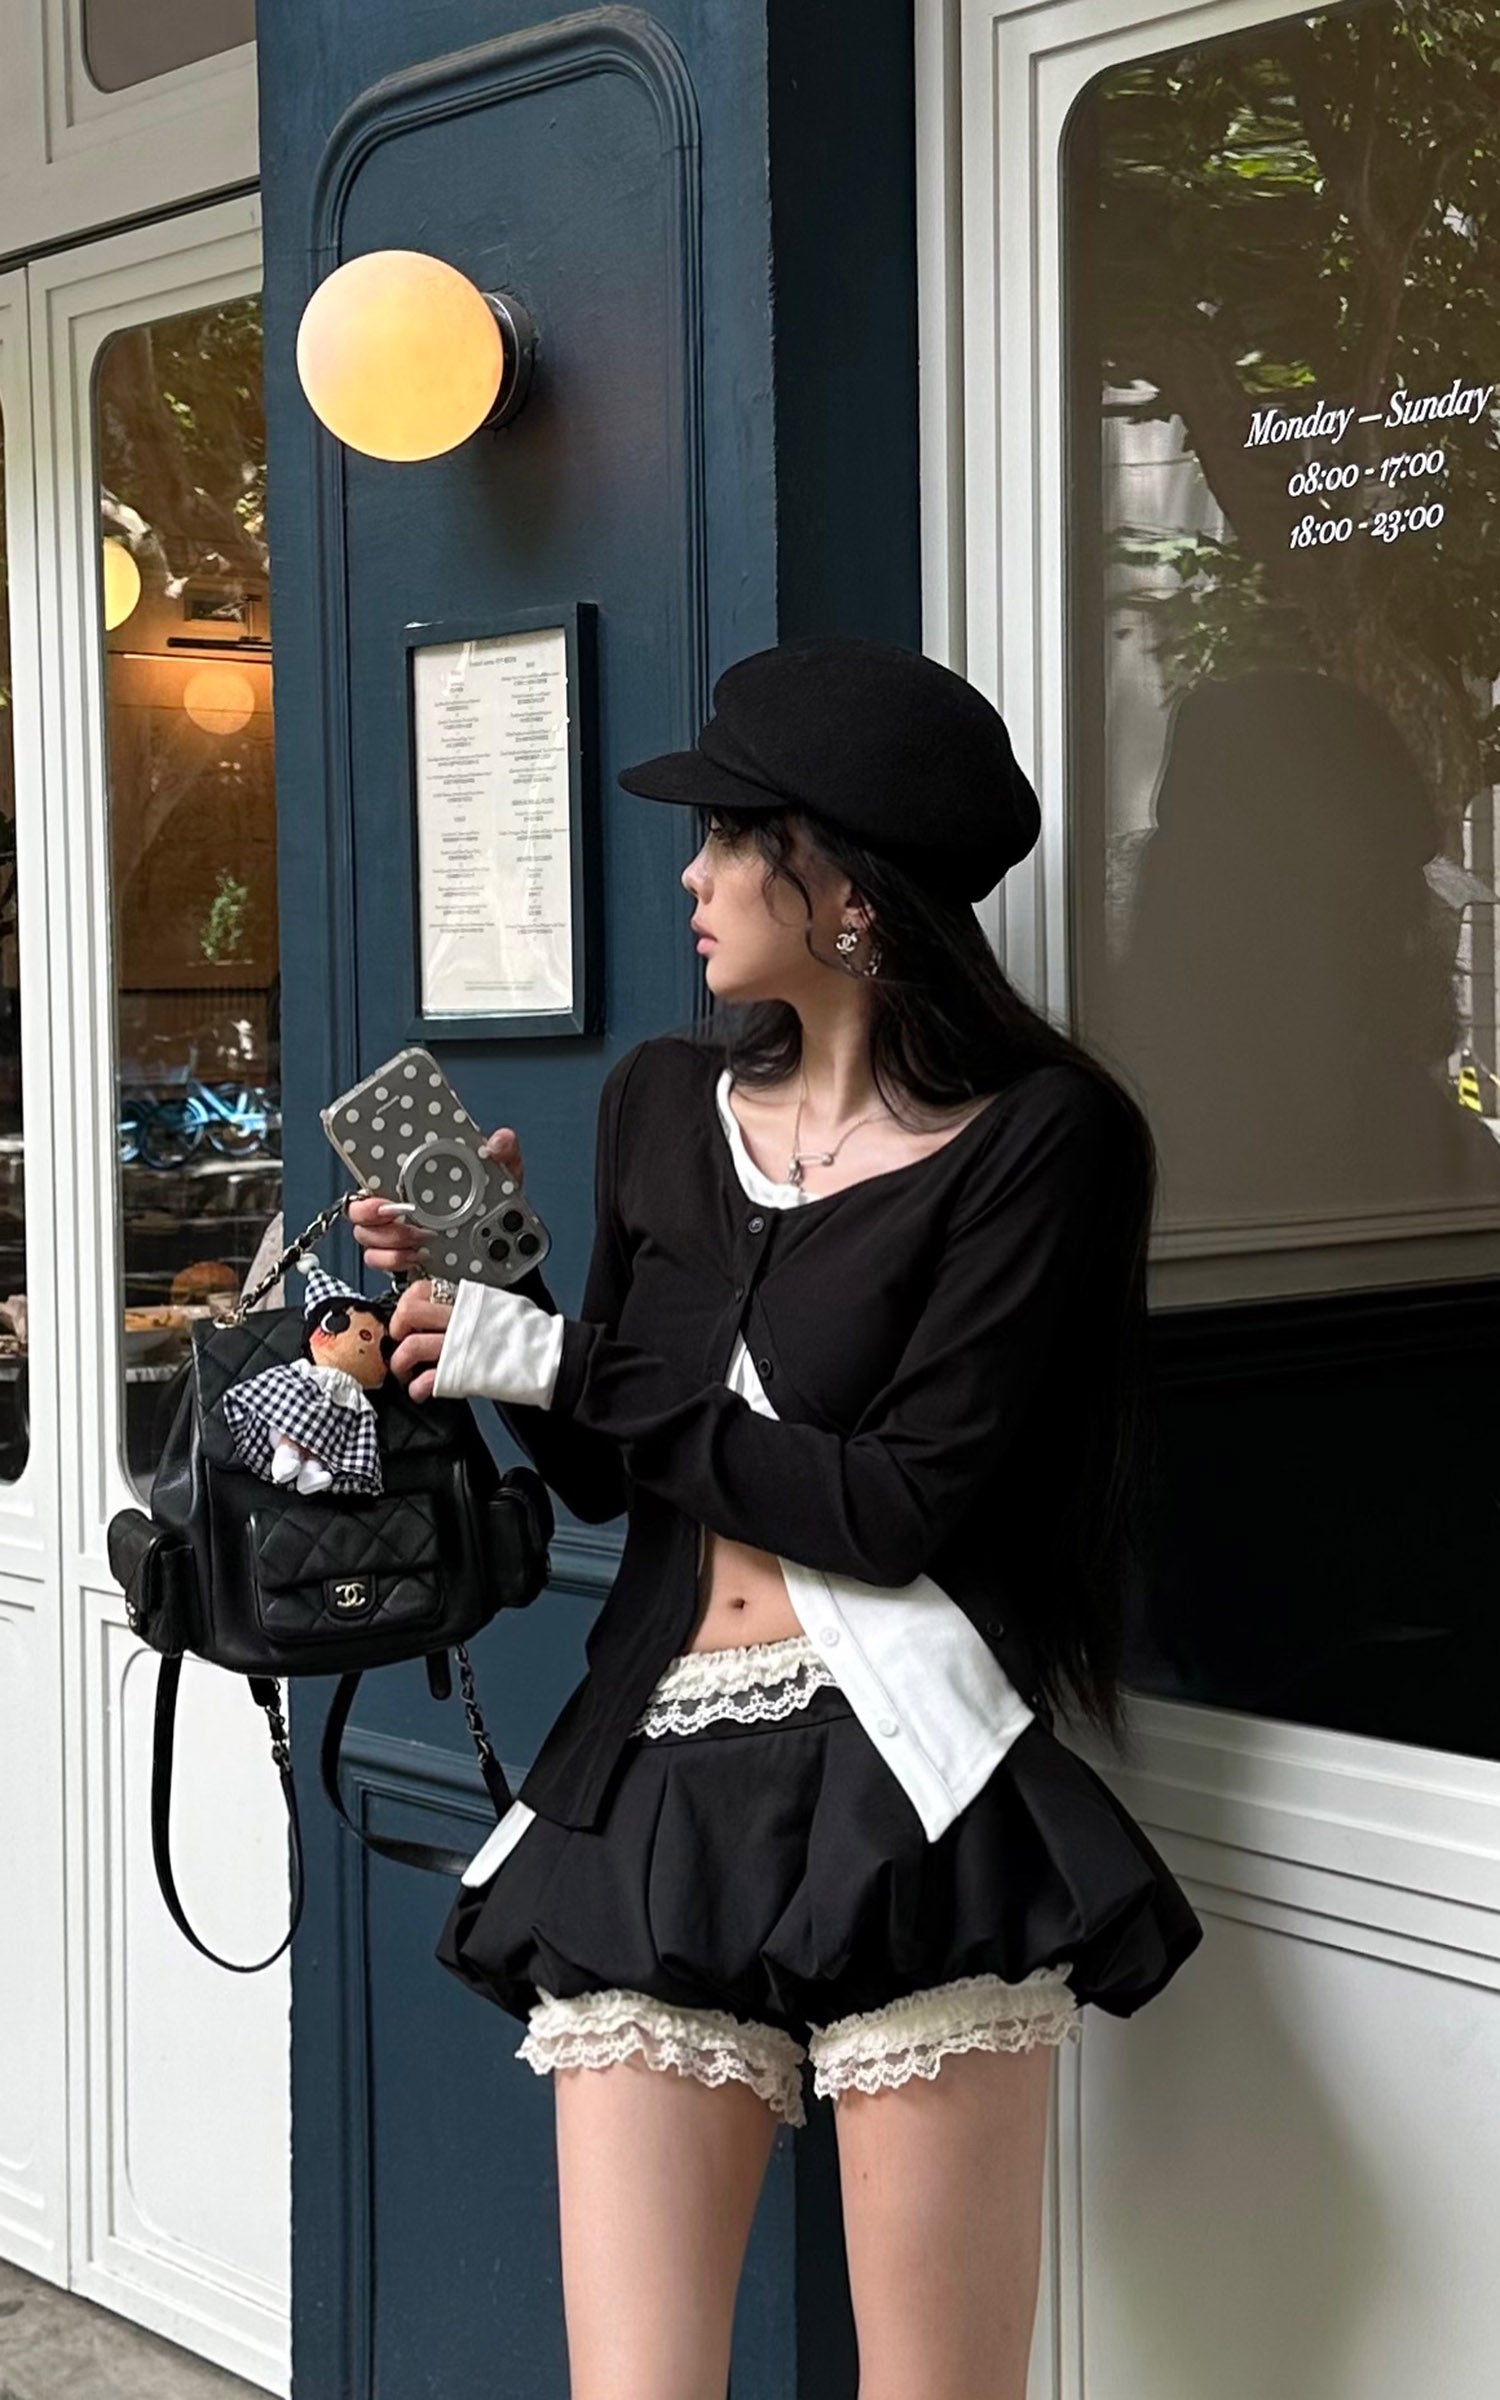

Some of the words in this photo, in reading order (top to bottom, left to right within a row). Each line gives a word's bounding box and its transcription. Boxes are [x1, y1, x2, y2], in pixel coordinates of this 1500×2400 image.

[1244, 400, 1355, 447] Monday
[1384, 379, 1494, 428] Sunday
[1288, 462, 1360, 497] 08:00
[1380, 449, 1445, 488] 17:00
[1290, 515, 1353, 549] 18:00
[1370, 503, 1444, 543] 23:00
